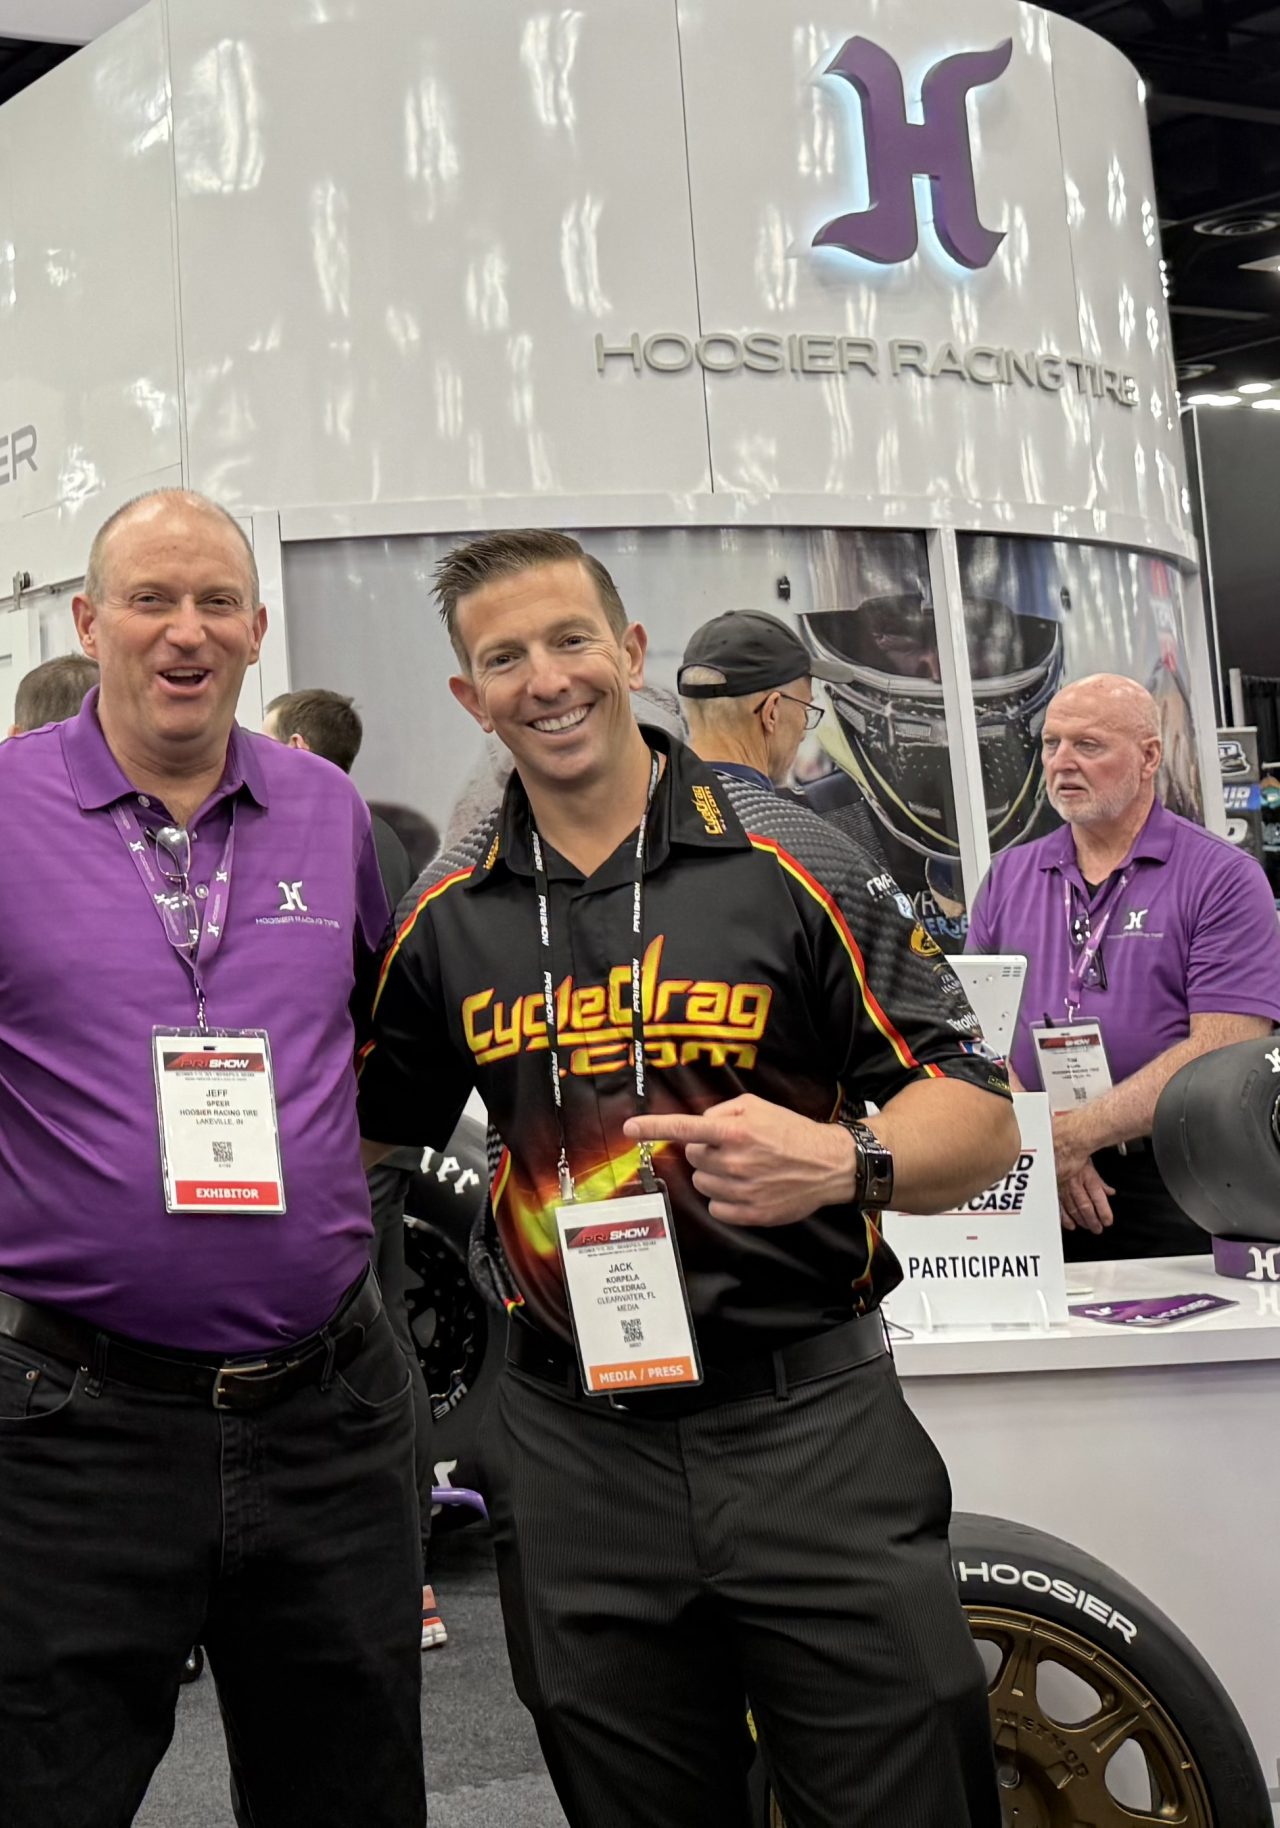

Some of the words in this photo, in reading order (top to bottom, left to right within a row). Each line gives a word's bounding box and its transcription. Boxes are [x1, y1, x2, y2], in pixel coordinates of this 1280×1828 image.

[595, 332, 878, 377] HOOSIER
[888, 338, 1064, 391] RACING
[1066, 356, 1138, 407] TIRE
[632, 958, 641, 1013] PRISHOW
[543, 971, 555, 1025] PRISHOW
[634, 1040, 645, 1097] PRISHOW
[551, 1051, 562, 1107] PRISHOW
[206, 1089, 228, 1098] JEFF
[180, 1108, 212, 1116] HOOSIER
[195, 1187, 259, 1200] EXHIBITOR
[608, 1262, 634, 1274] JACK
[908, 1255, 1041, 1278] PARTICIPANT
[606, 1274, 640, 1284] KORPELA
[603, 1283, 646, 1294] CYCLEDRAG
[646, 1291, 656, 1299] FL
[616, 1304, 640, 1312] MEDIA
[599, 1368, 637, 1384] MEDIA
[648, 1365, 684, 1378] PRESS
[958, 1560, 1138, 1645] HOOSIER
